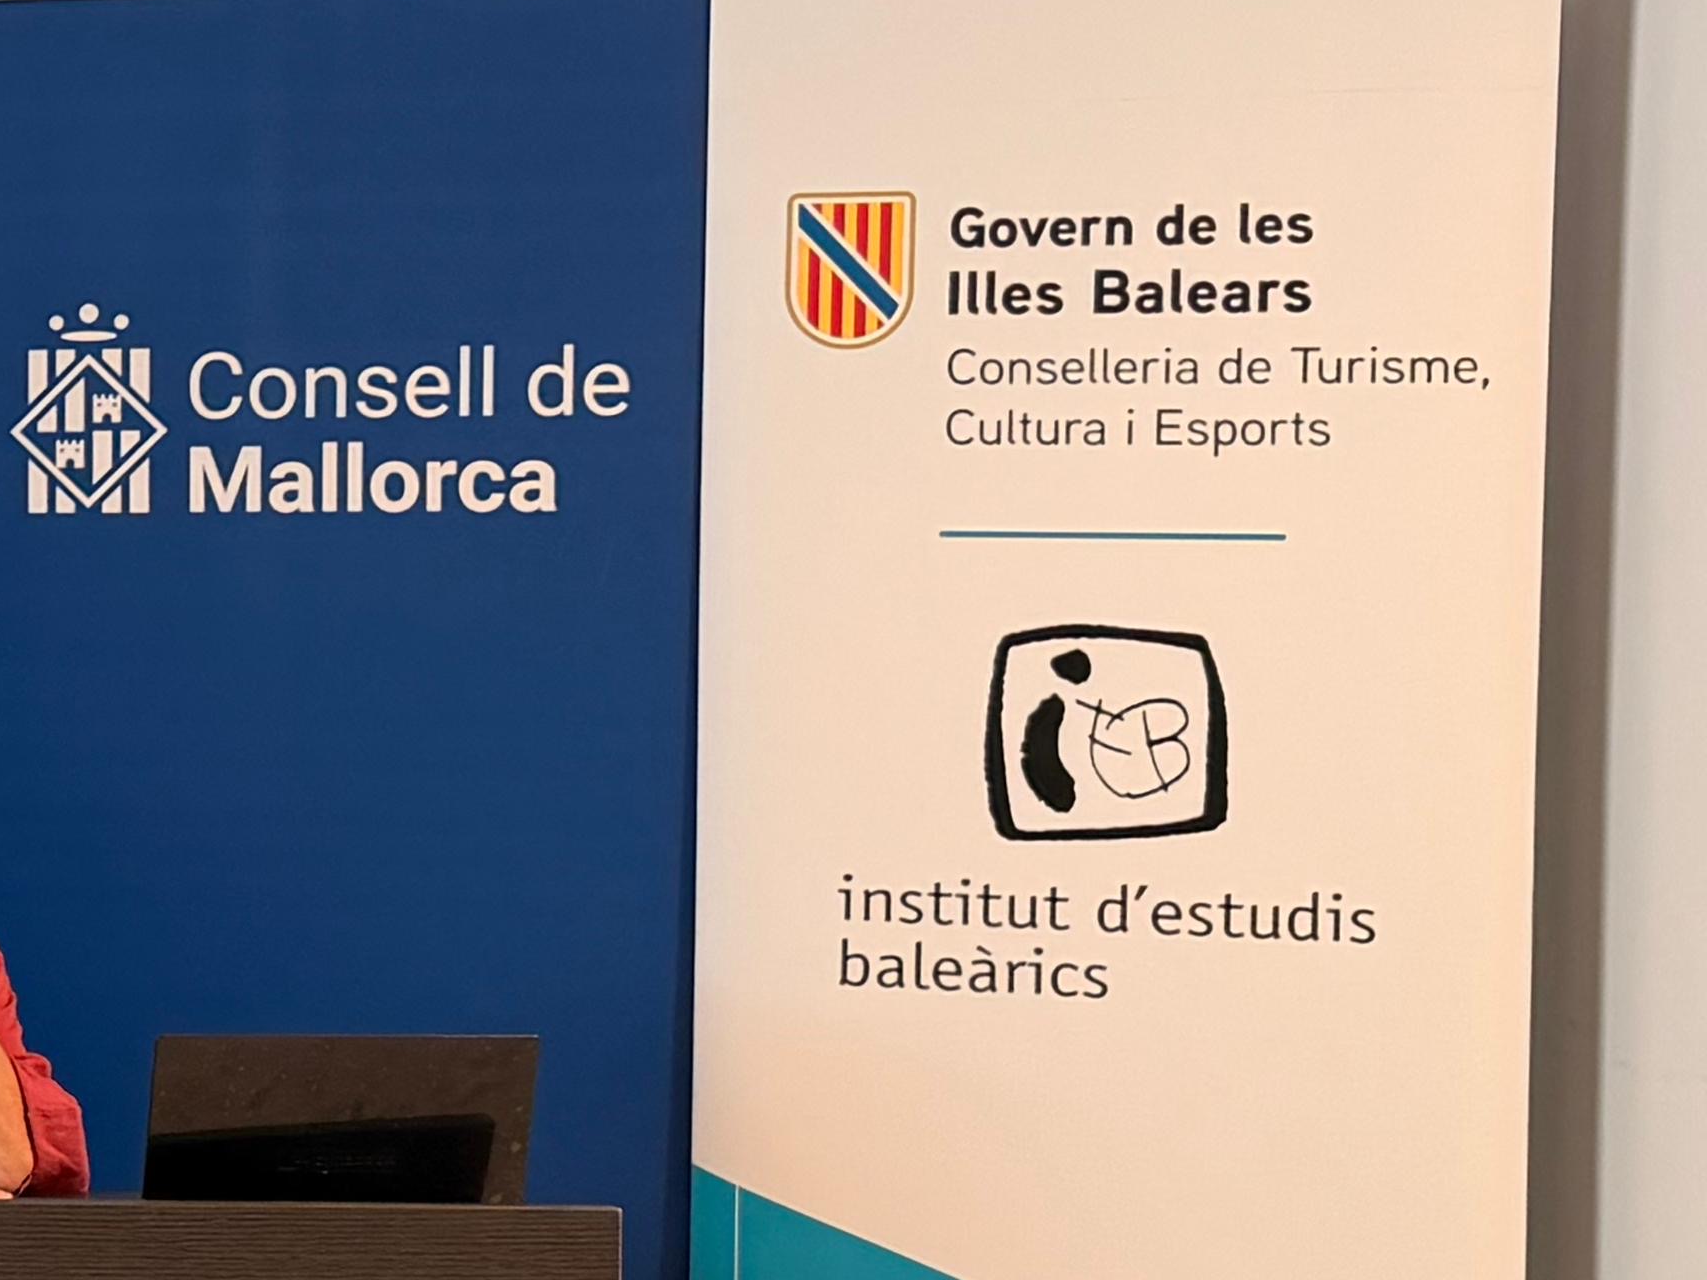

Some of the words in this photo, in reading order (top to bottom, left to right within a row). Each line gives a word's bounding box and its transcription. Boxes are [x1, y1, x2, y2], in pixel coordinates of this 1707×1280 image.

[949, 207, 1134, 248] Govern
[1156, 204, 1217, 246] de
[1239, 203, 1314, 245] les
[947, 271, 1064, 316] Illes
[1093, 268, 1312, 315] Balears
[189, 345, 494, 419] Consell
[528, 344, 630, 417] de
[946, 347, 1199, 386] Conselleria
[1218, 348, 1272, 385] de
[1292, 346, 1492, 391] Turisme,
[946, 409, 1106, 447] Cultura
[1127, 410, 1134, 446] i
[1156, 409, 1331, 457] Esports
[189, 440, 557, 514] Mallorca
[837, 874, 1070, 931] institut
[838, 938, 1109, 1000] baleàrics
